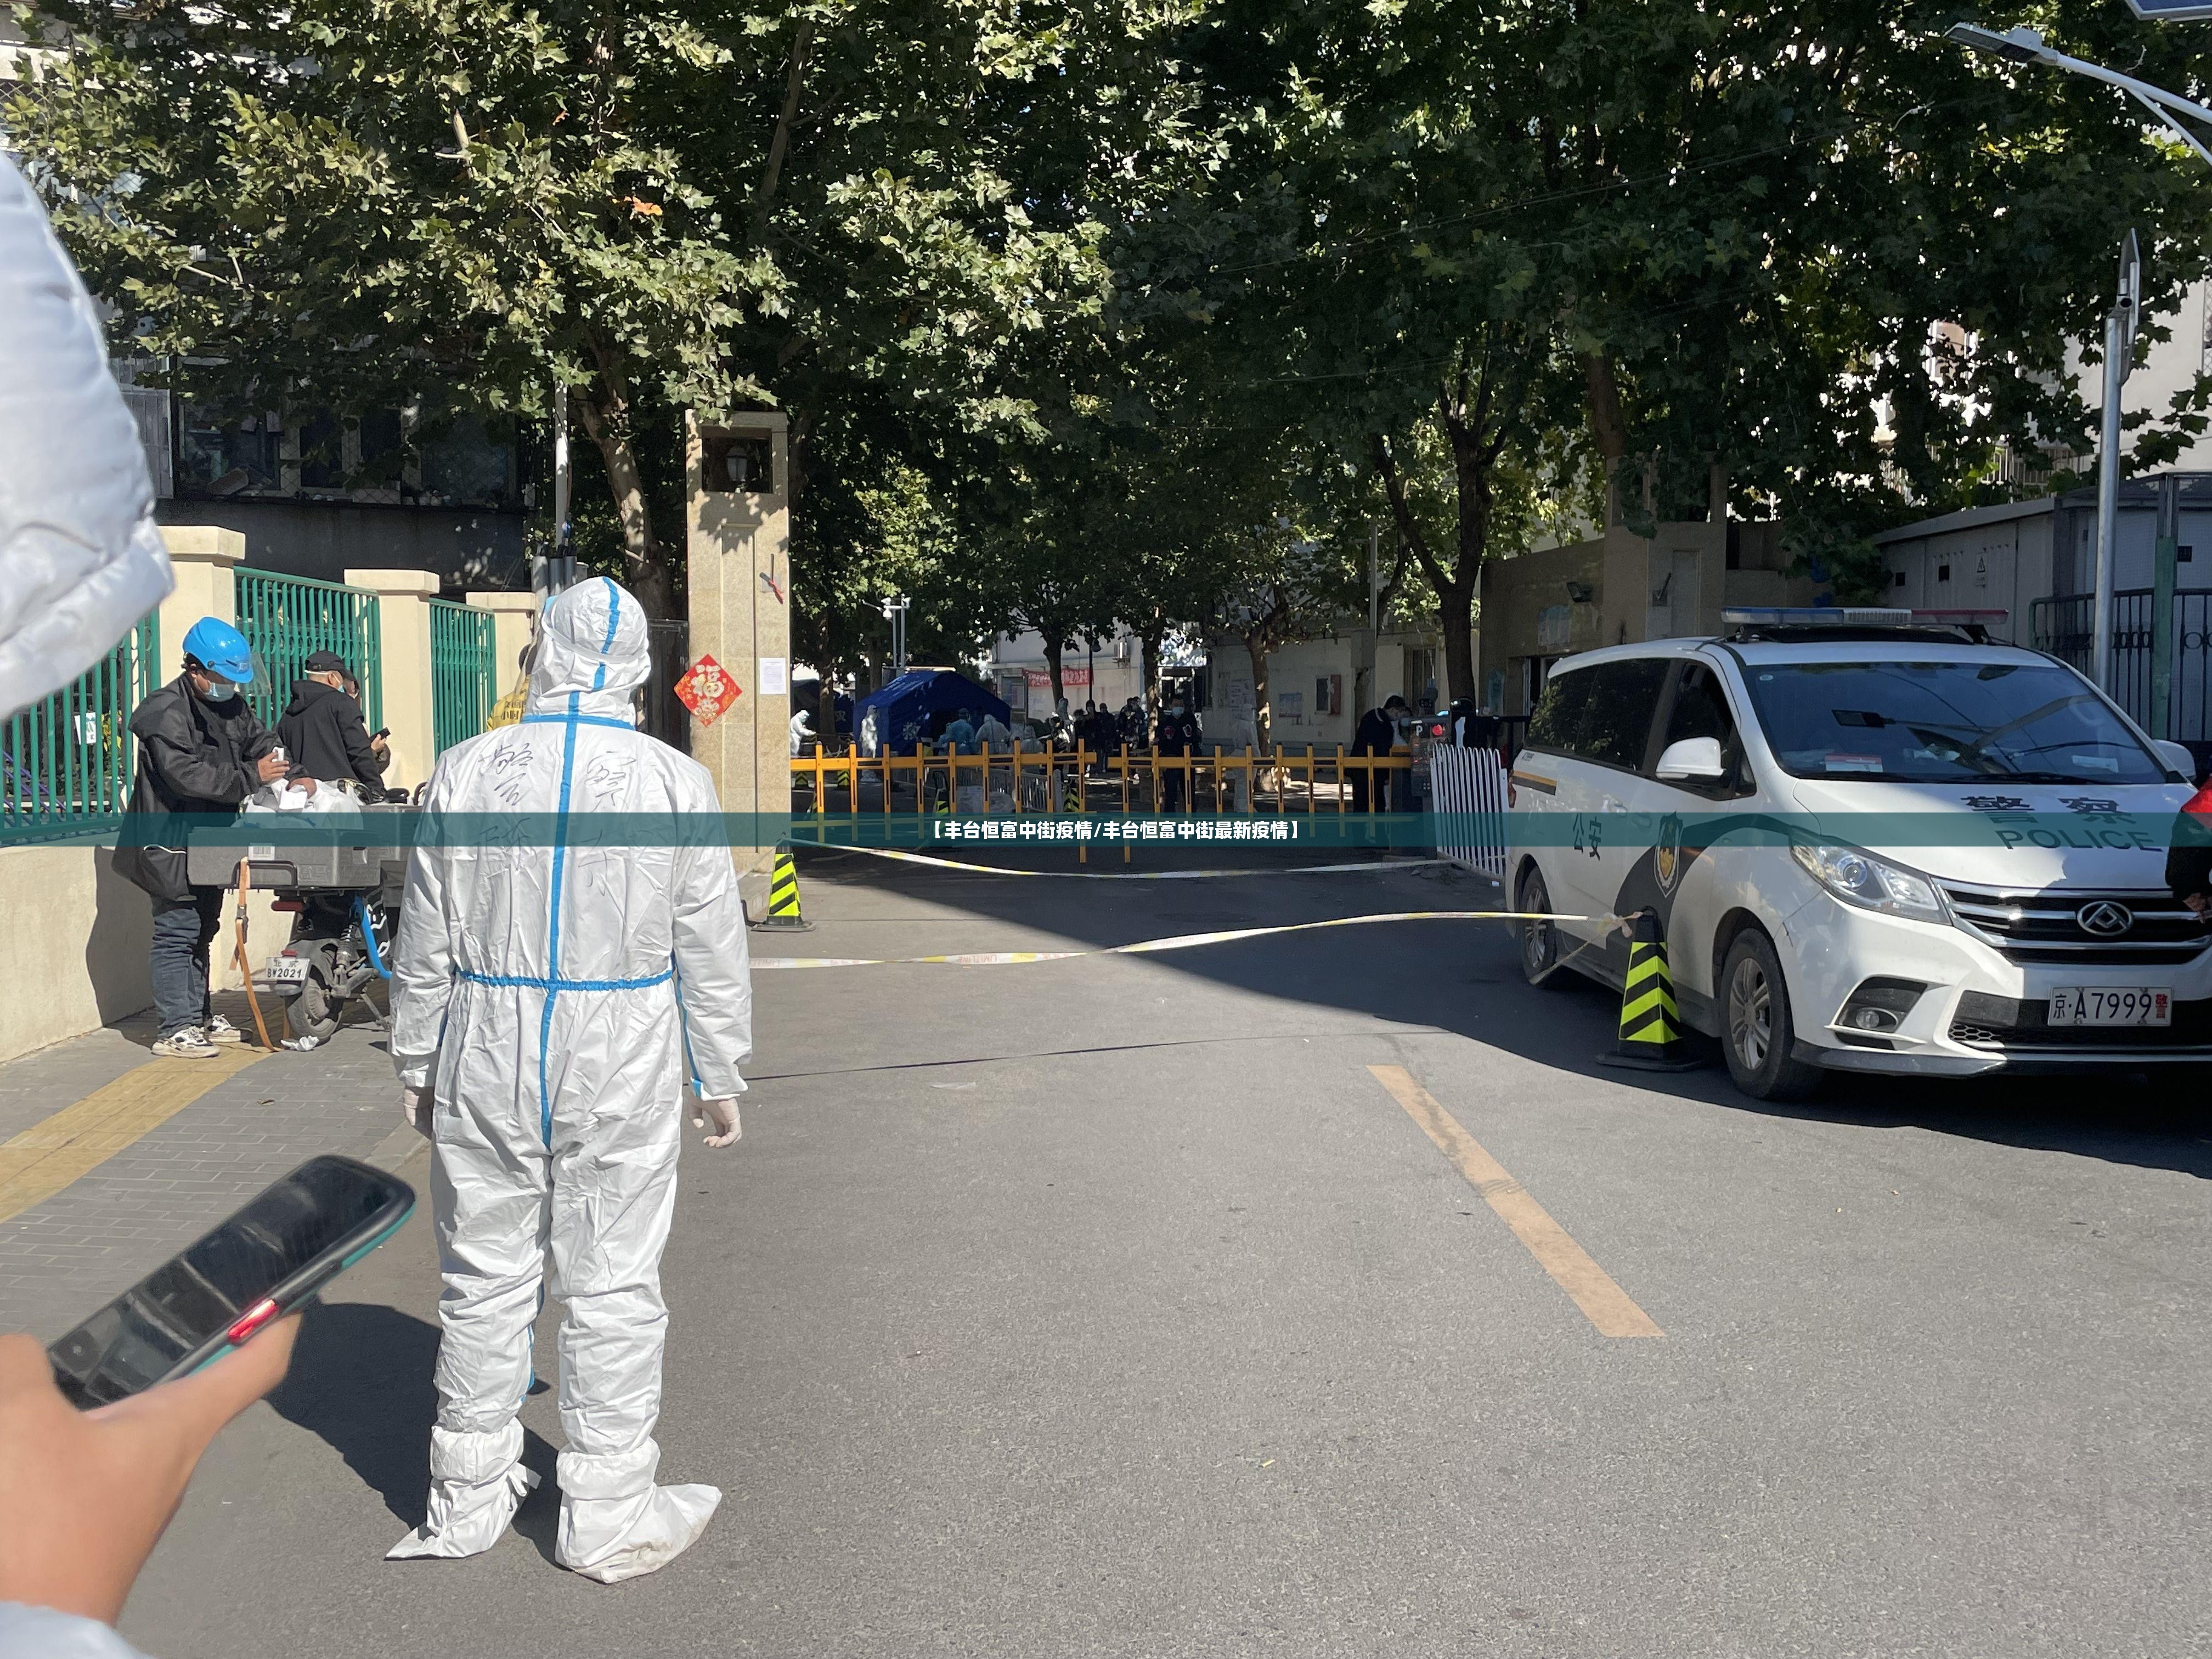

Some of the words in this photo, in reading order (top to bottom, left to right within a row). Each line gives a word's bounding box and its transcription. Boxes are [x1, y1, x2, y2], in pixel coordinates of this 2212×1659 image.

[691, 664, 725, 698] 福
[1961, 795, 2137, 825] 警察
[1572, 812, 1602, 861] 公安
[1995, 829, 2163, 852] POLICE
